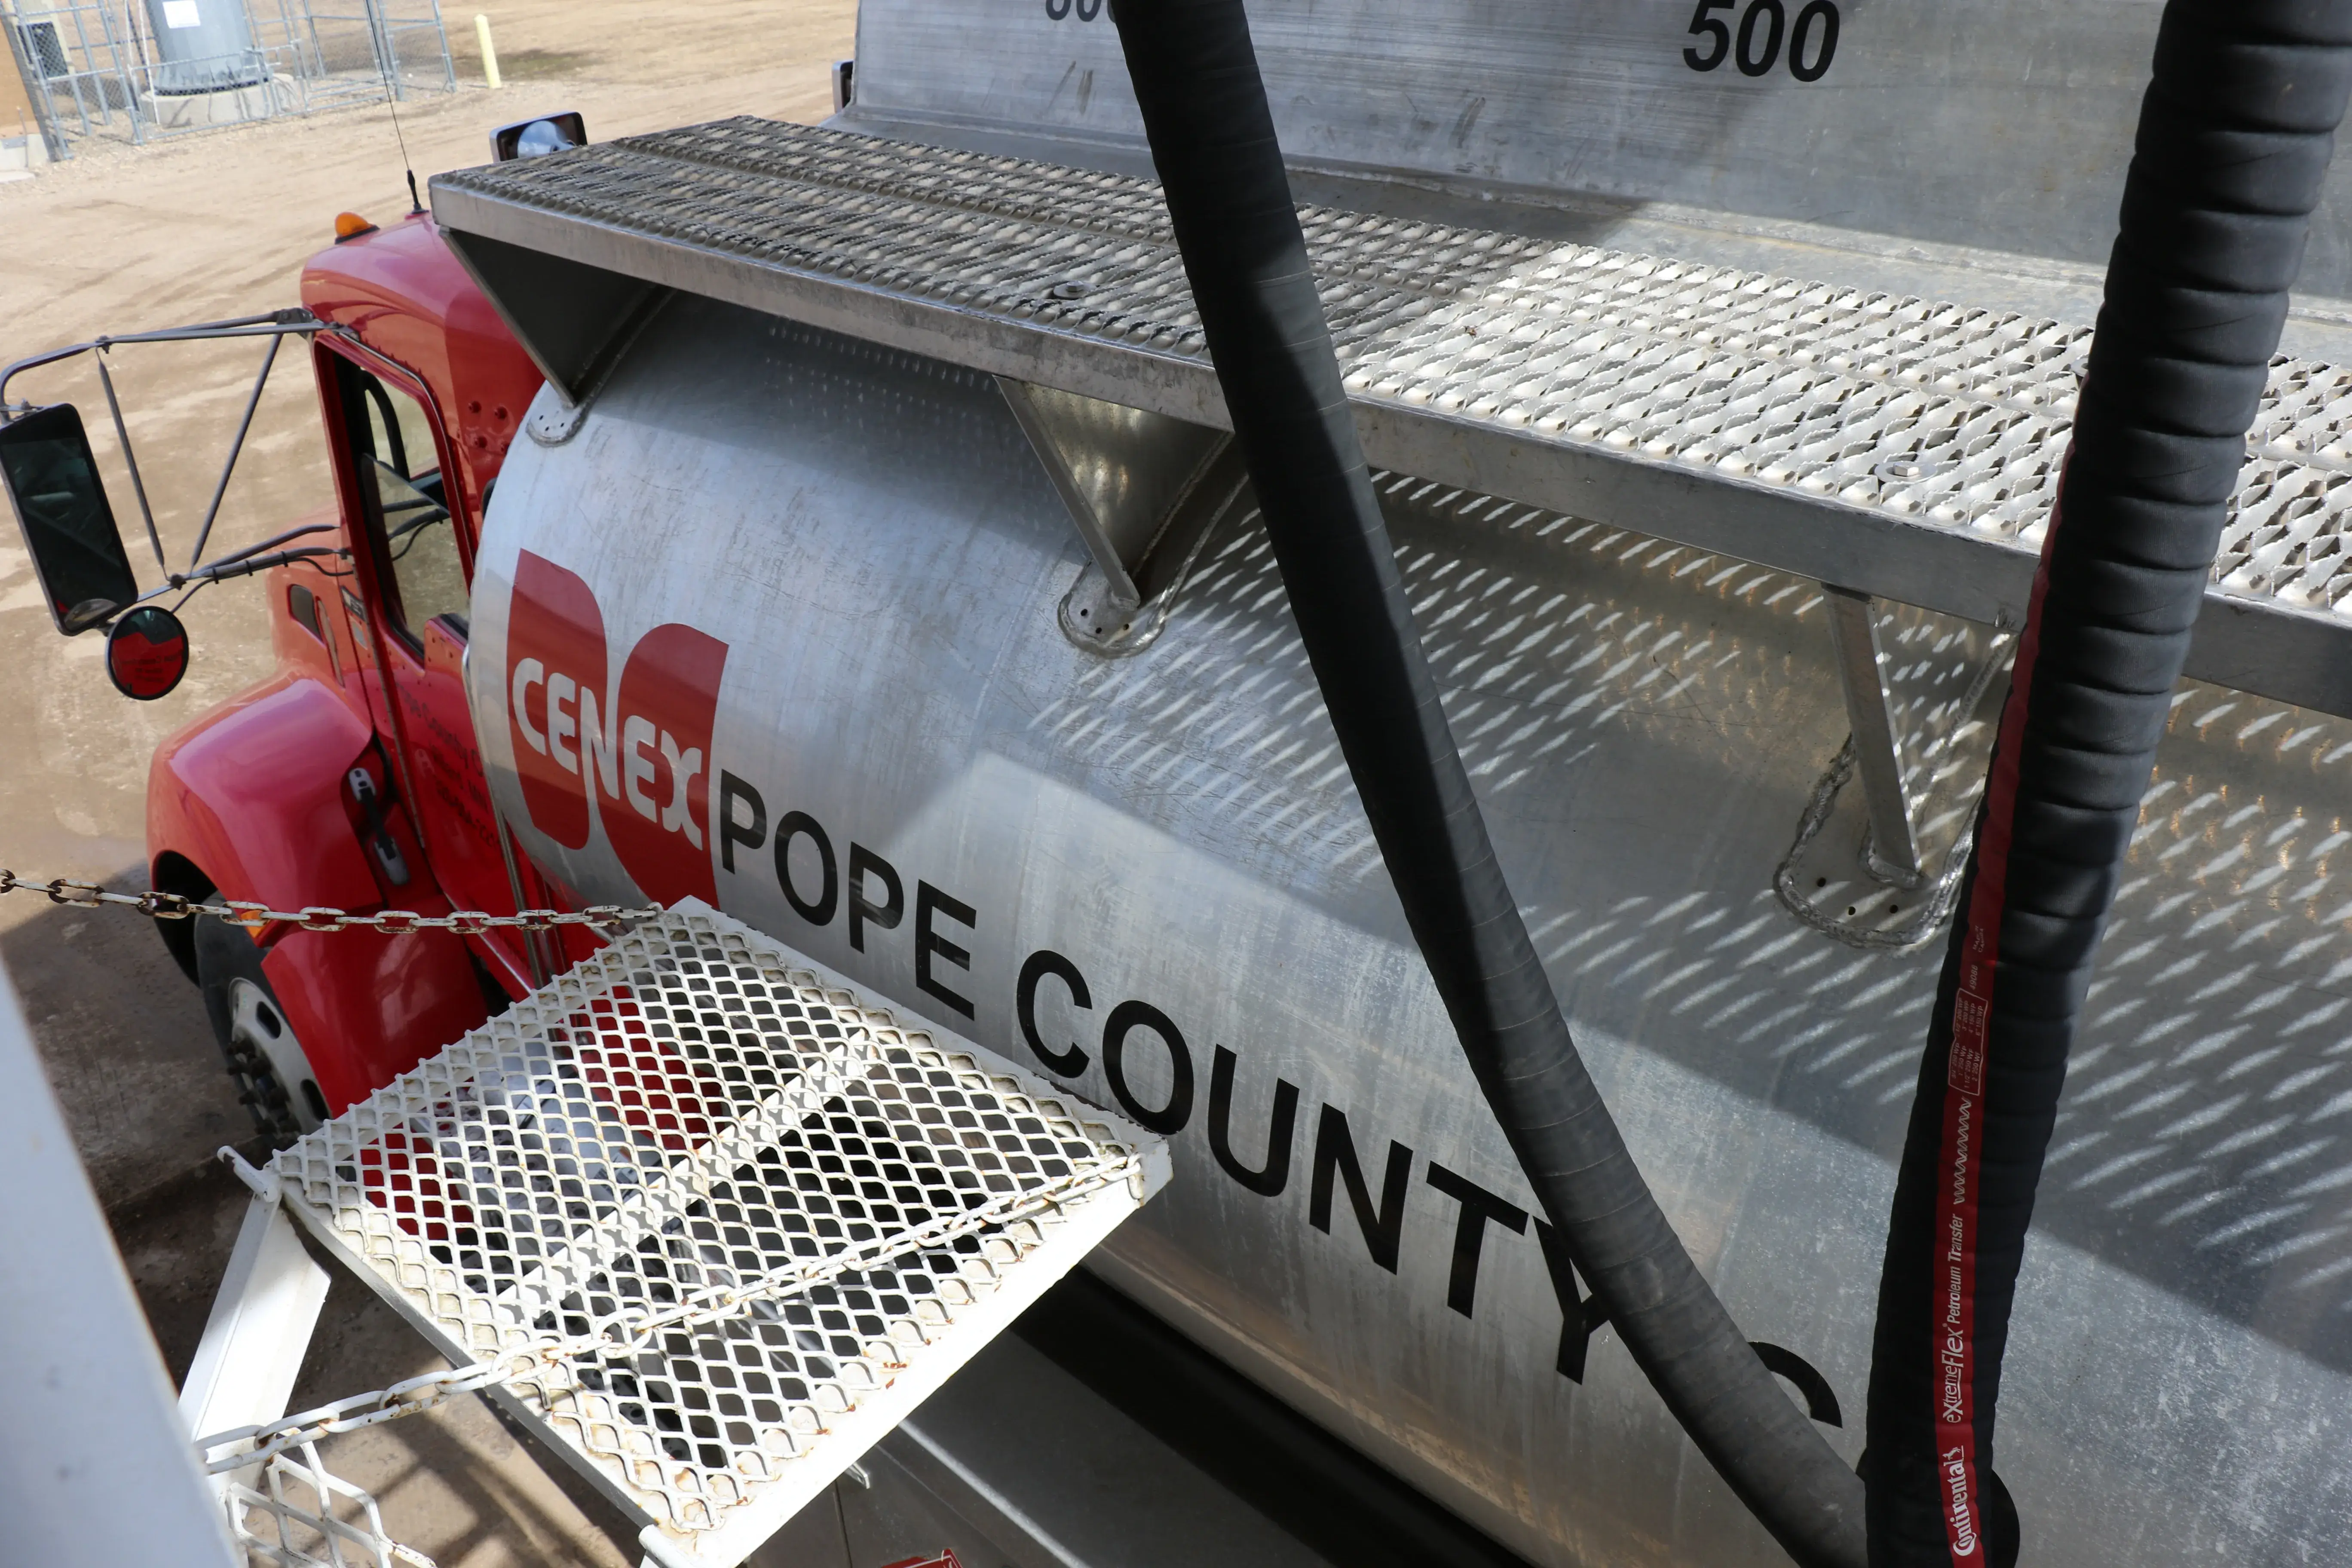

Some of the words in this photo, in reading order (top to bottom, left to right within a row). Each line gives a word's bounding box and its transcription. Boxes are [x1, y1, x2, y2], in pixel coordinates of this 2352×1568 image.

[1683, 0, 1840, 82] 500
[512, 658, 703, 851] CENEX
[1970, 1003, 1976, 1014] WP
[1976, 1006, 1983, 1017] WP
[1954, 1043, 1960, 1054] WP
[1960, 1046, 1966, 1057] WP
[720, 769, 977, 1022] POPE
[1016, 949, 1614, 1385] COUNTY
[1947, 1213, 1963, 1262] Transfer
[1947, 1266, 1962, 1325] Petroleum
[1943, 1458, 1977, 1556] Continental
